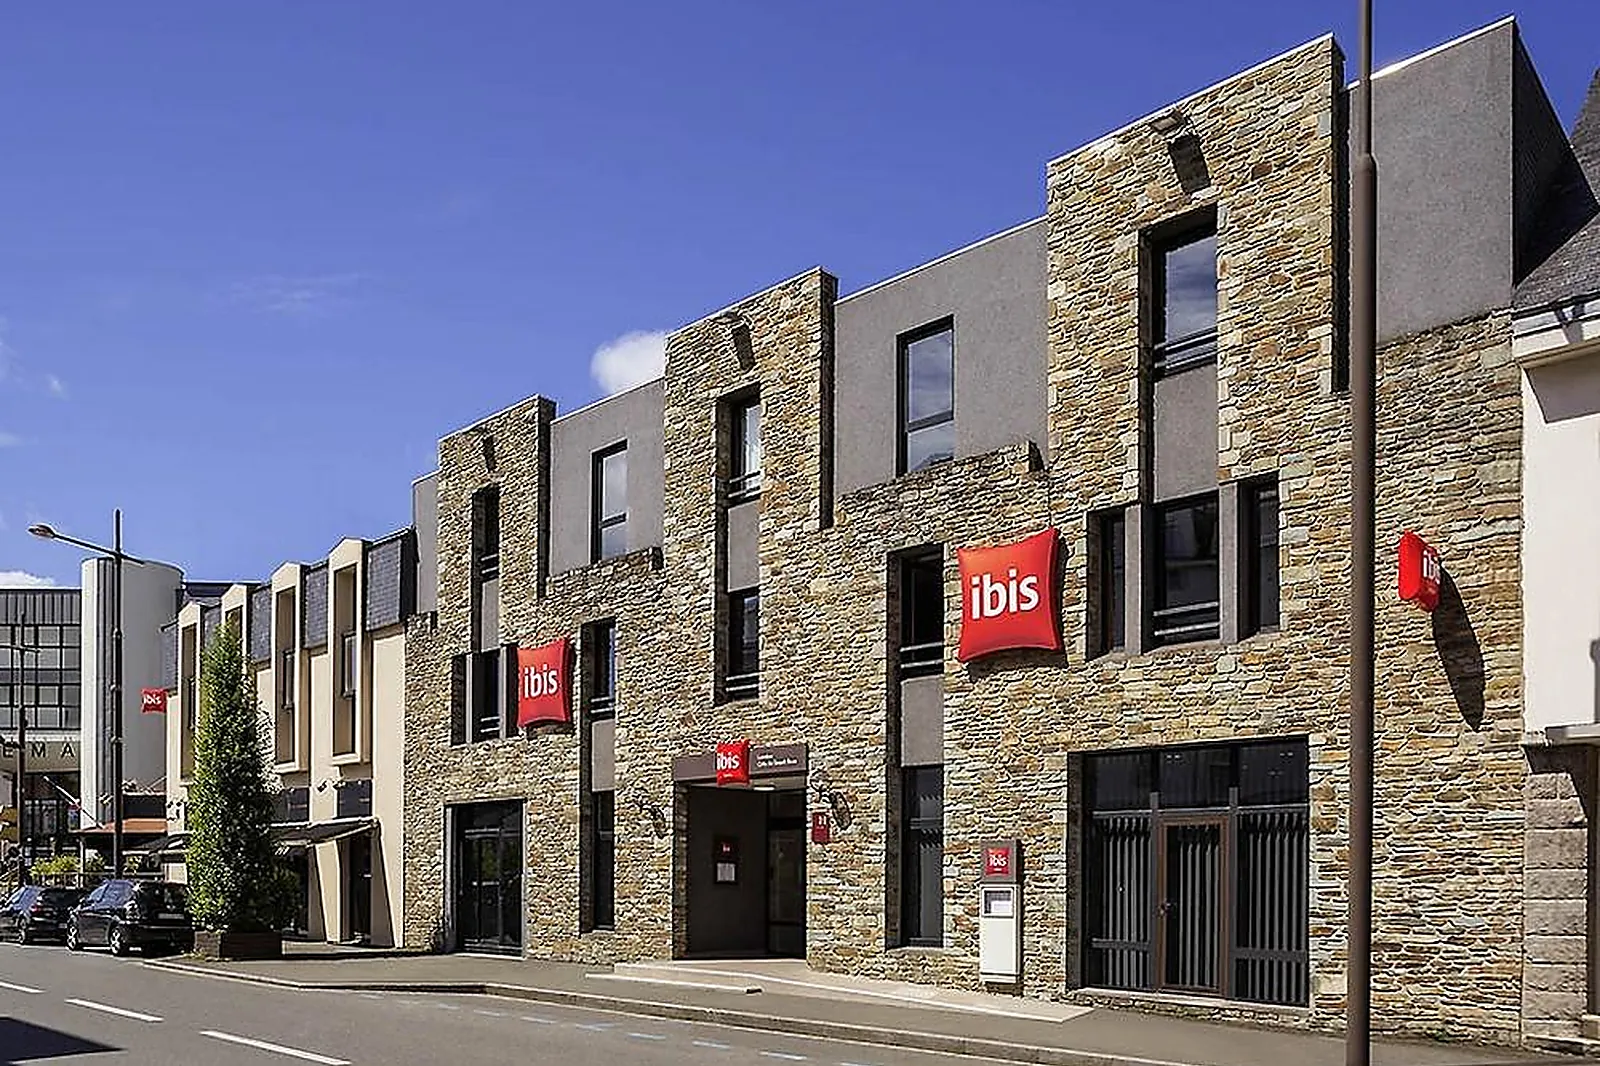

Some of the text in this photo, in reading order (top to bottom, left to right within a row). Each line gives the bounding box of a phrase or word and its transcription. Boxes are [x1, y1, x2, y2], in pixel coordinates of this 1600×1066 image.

[971, 568, 1040, 620] ibis
[524, 663, 558, 698] ibis
[716, 752, 740, 770] ibis
[989, 854, 1007, 867] ibis
